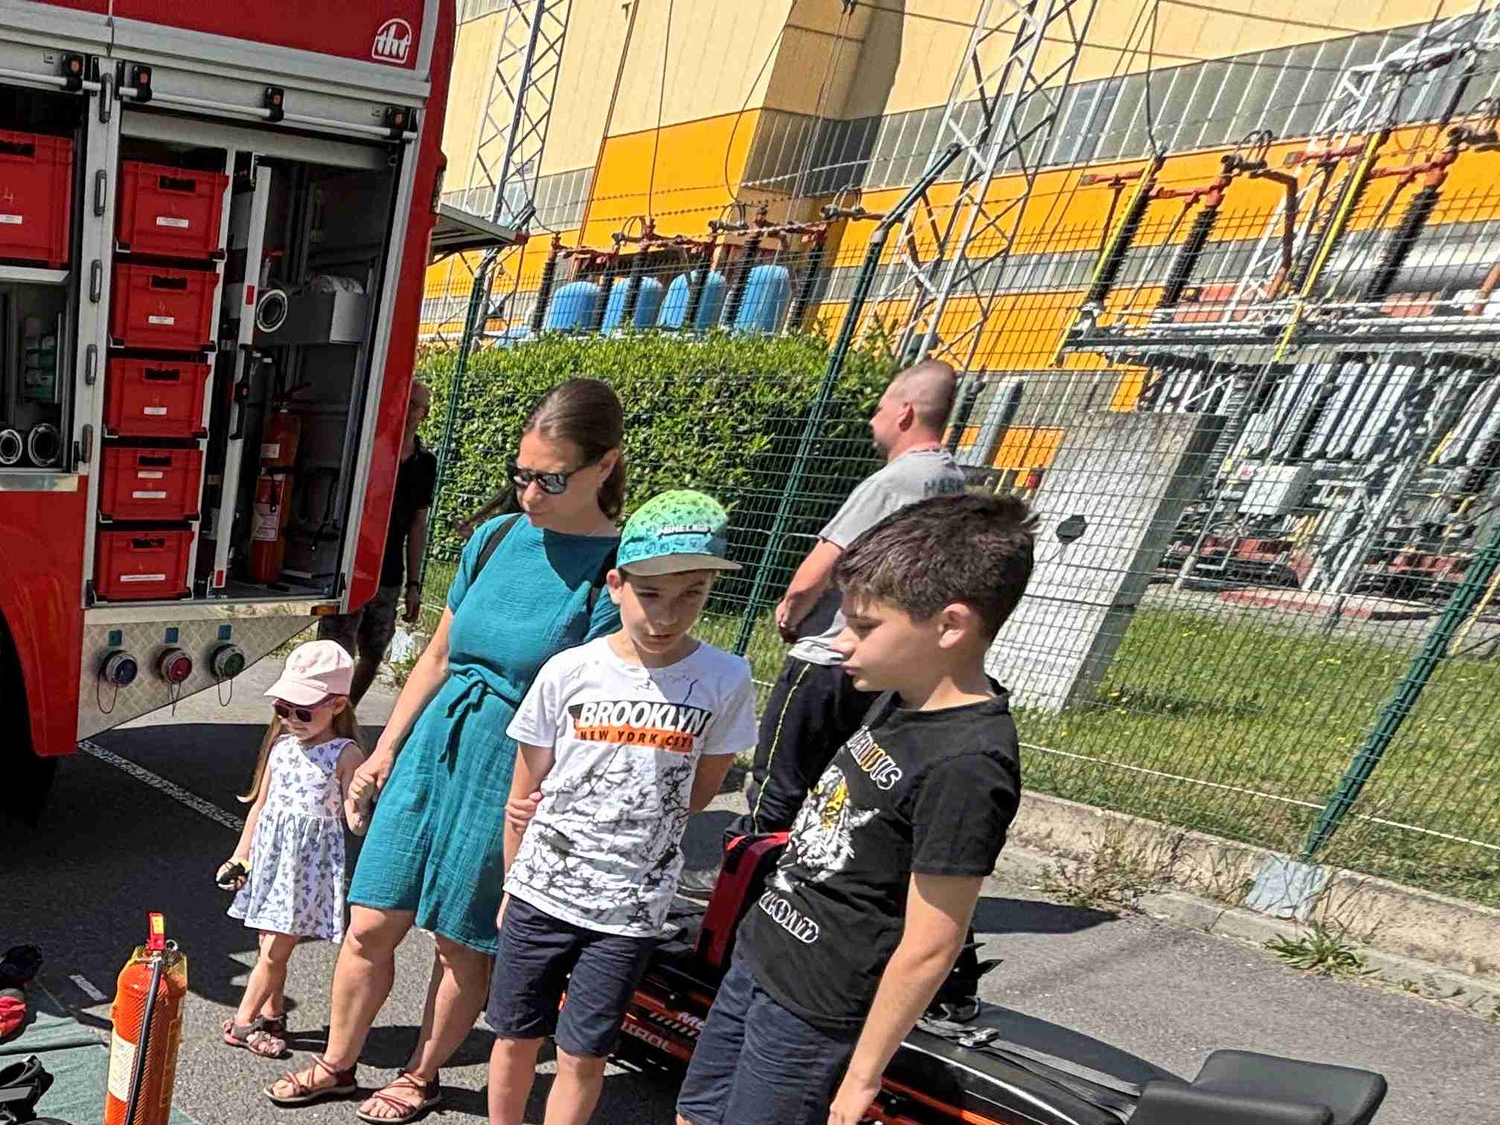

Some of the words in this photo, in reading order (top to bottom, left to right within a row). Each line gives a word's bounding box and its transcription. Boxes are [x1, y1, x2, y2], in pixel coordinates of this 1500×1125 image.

[579, 700, 710, 735] BROOKLYN
[579, 730, 610, 742] NEW
[617, 731, 659, 744] YORK
